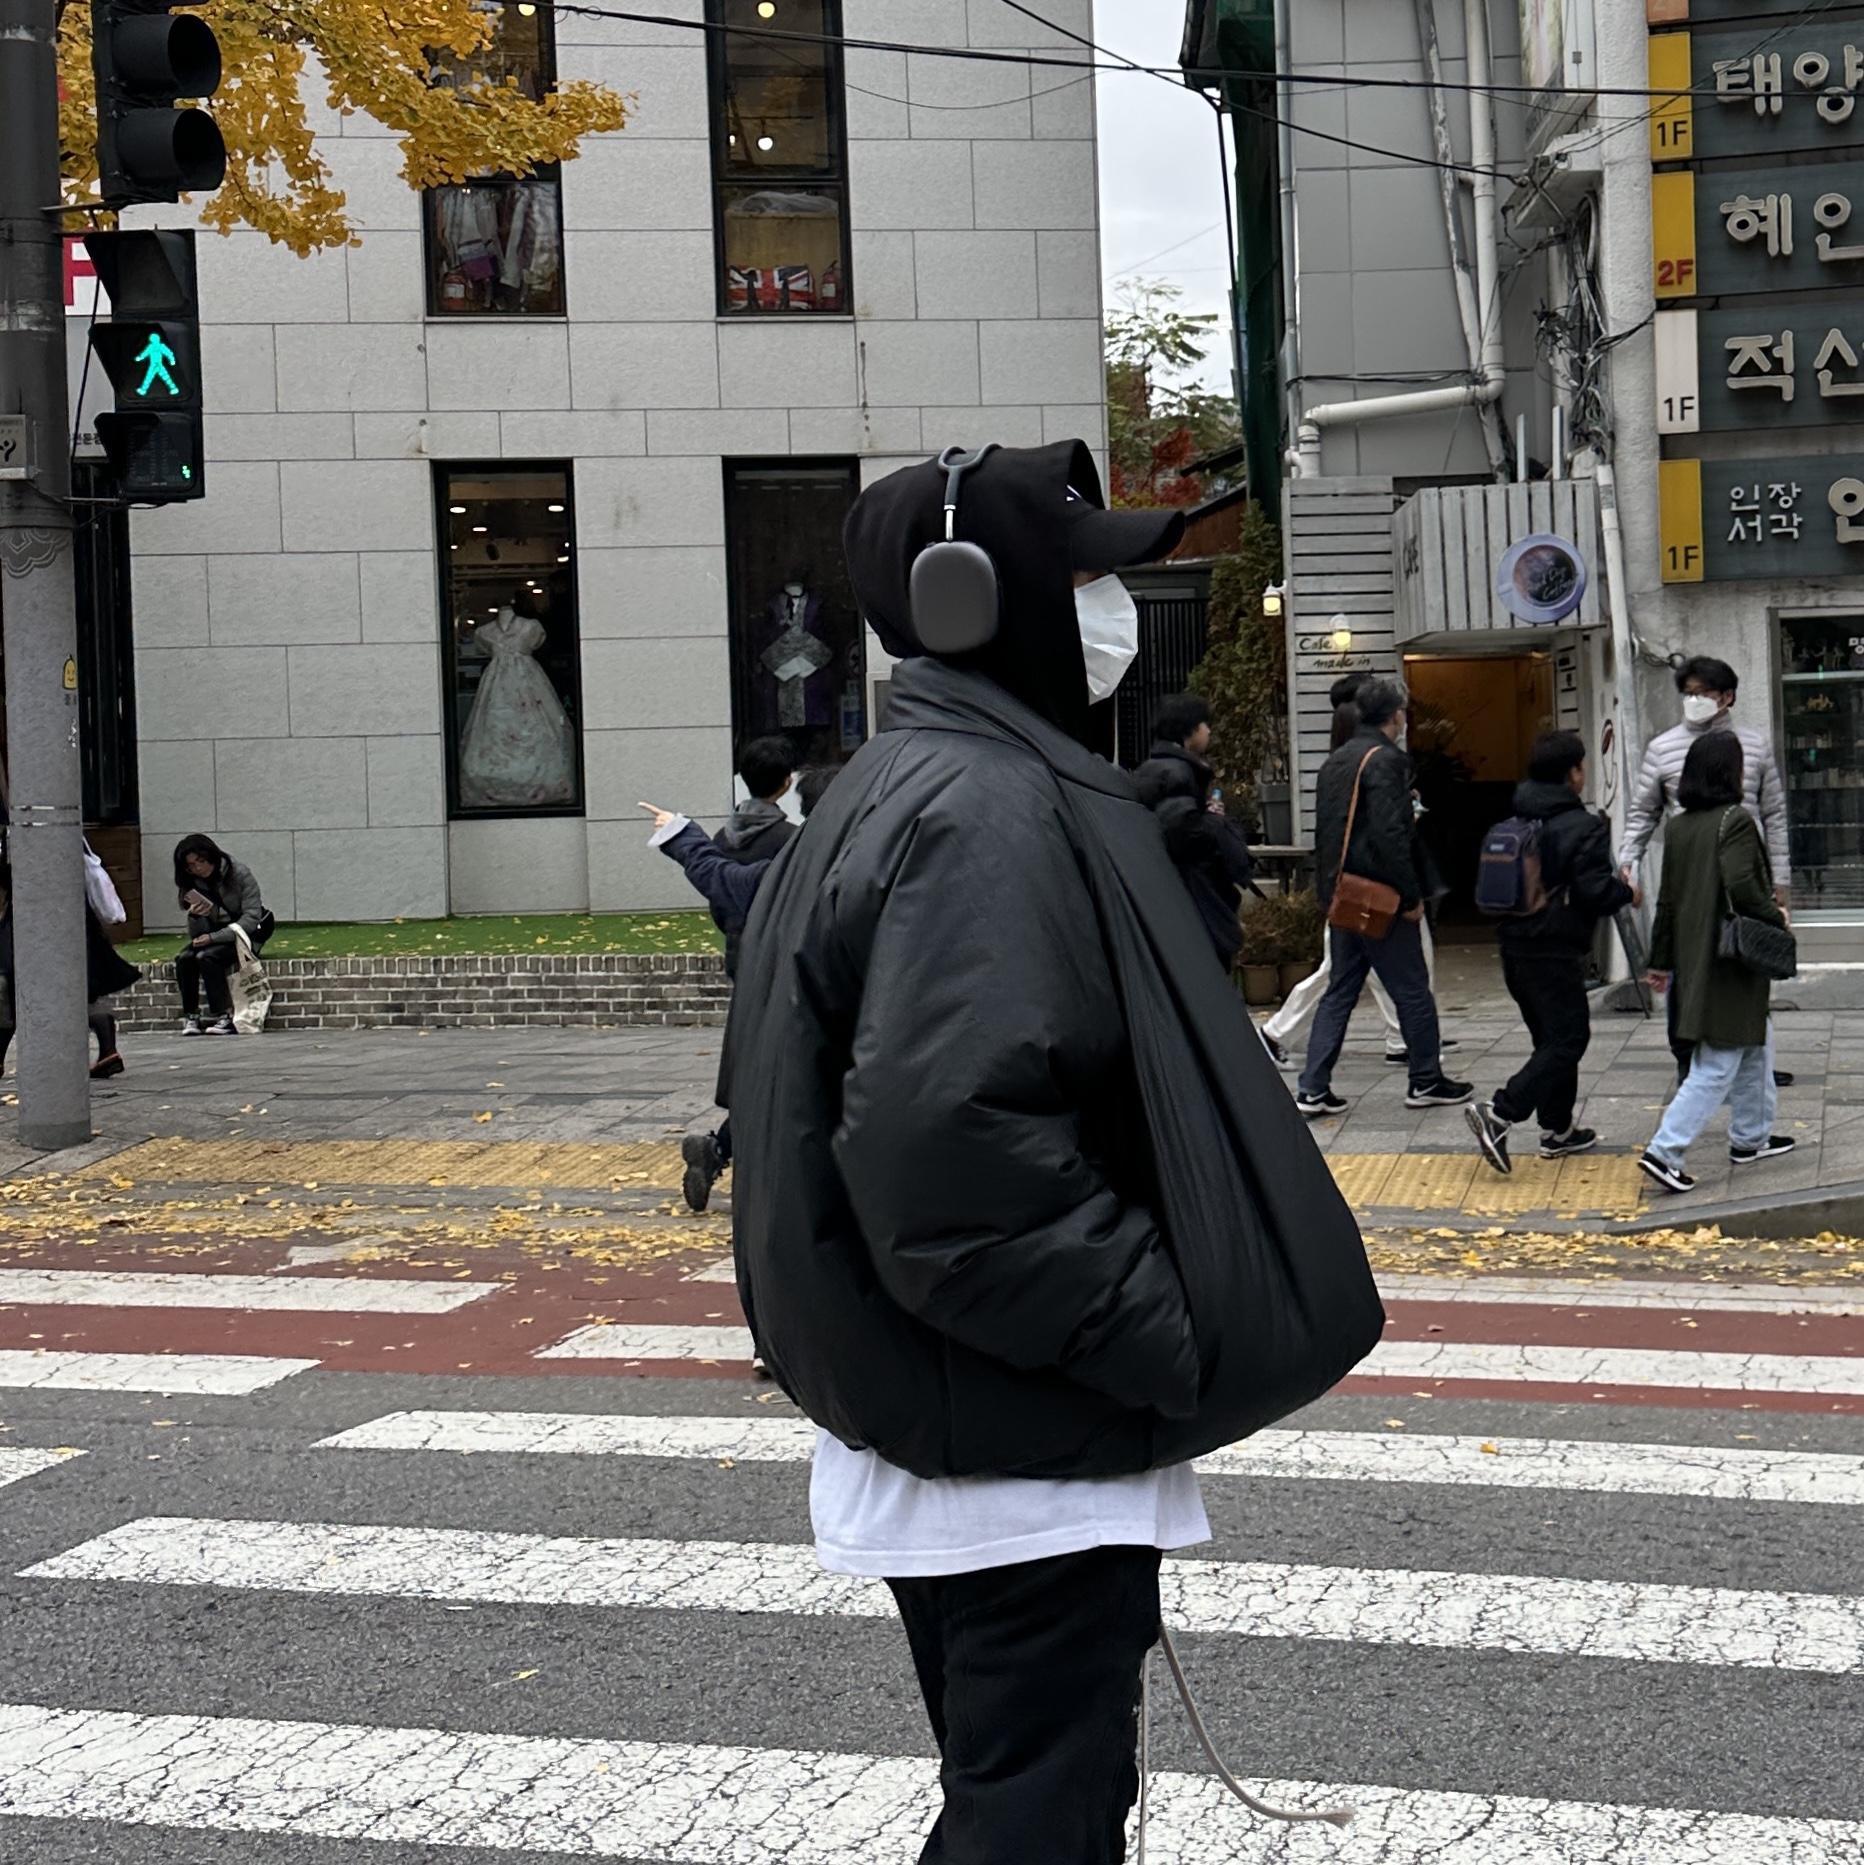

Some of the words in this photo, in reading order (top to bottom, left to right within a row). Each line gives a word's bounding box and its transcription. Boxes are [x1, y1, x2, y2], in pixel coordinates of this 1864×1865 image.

[1656, 120, 1688, 146] 1F
[1658, 259, 1693, 286] 2F
[1664, 396, 1694, 421] 1F
[1730, 482, 1802, 511] 인장
[1727, 512, 1803, 542] 서각
[1668, 546, 1698, 570] 1F
[1313, 650, 1353, 669] made
